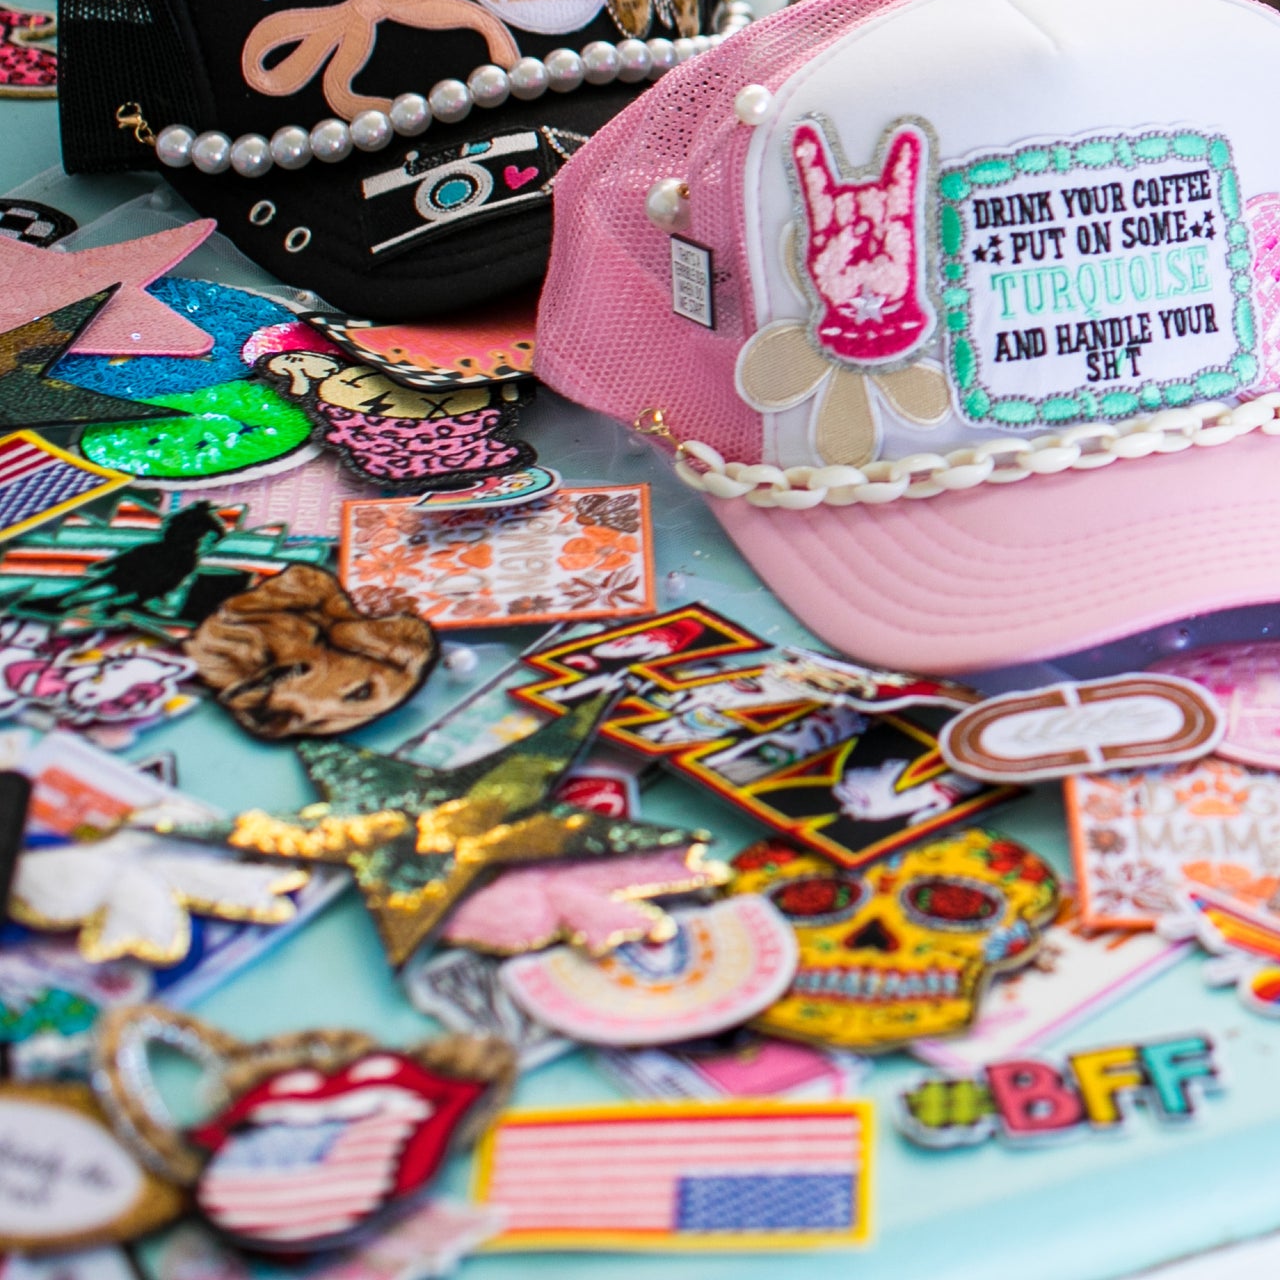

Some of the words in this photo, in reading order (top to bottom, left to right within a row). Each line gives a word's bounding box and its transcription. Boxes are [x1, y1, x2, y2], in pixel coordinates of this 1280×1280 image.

[972, 190, 1054, 230] DRINK
[1061, 181, 1127, 219] YOUR
[1133, 169, 1213, 209] COFFEE
[1010, 226, 1066, 264] PUT
[1076, 220, 1112, 255] ON
[1121, 209, 1189, 249] SOME
[989, 244, 1213, 320] TURQUOISE
[994, 326, 1048, 363] AND
[1055, 311, 1153, 355] HANDLE
[1158, 302, 1219, 339] YOUR
